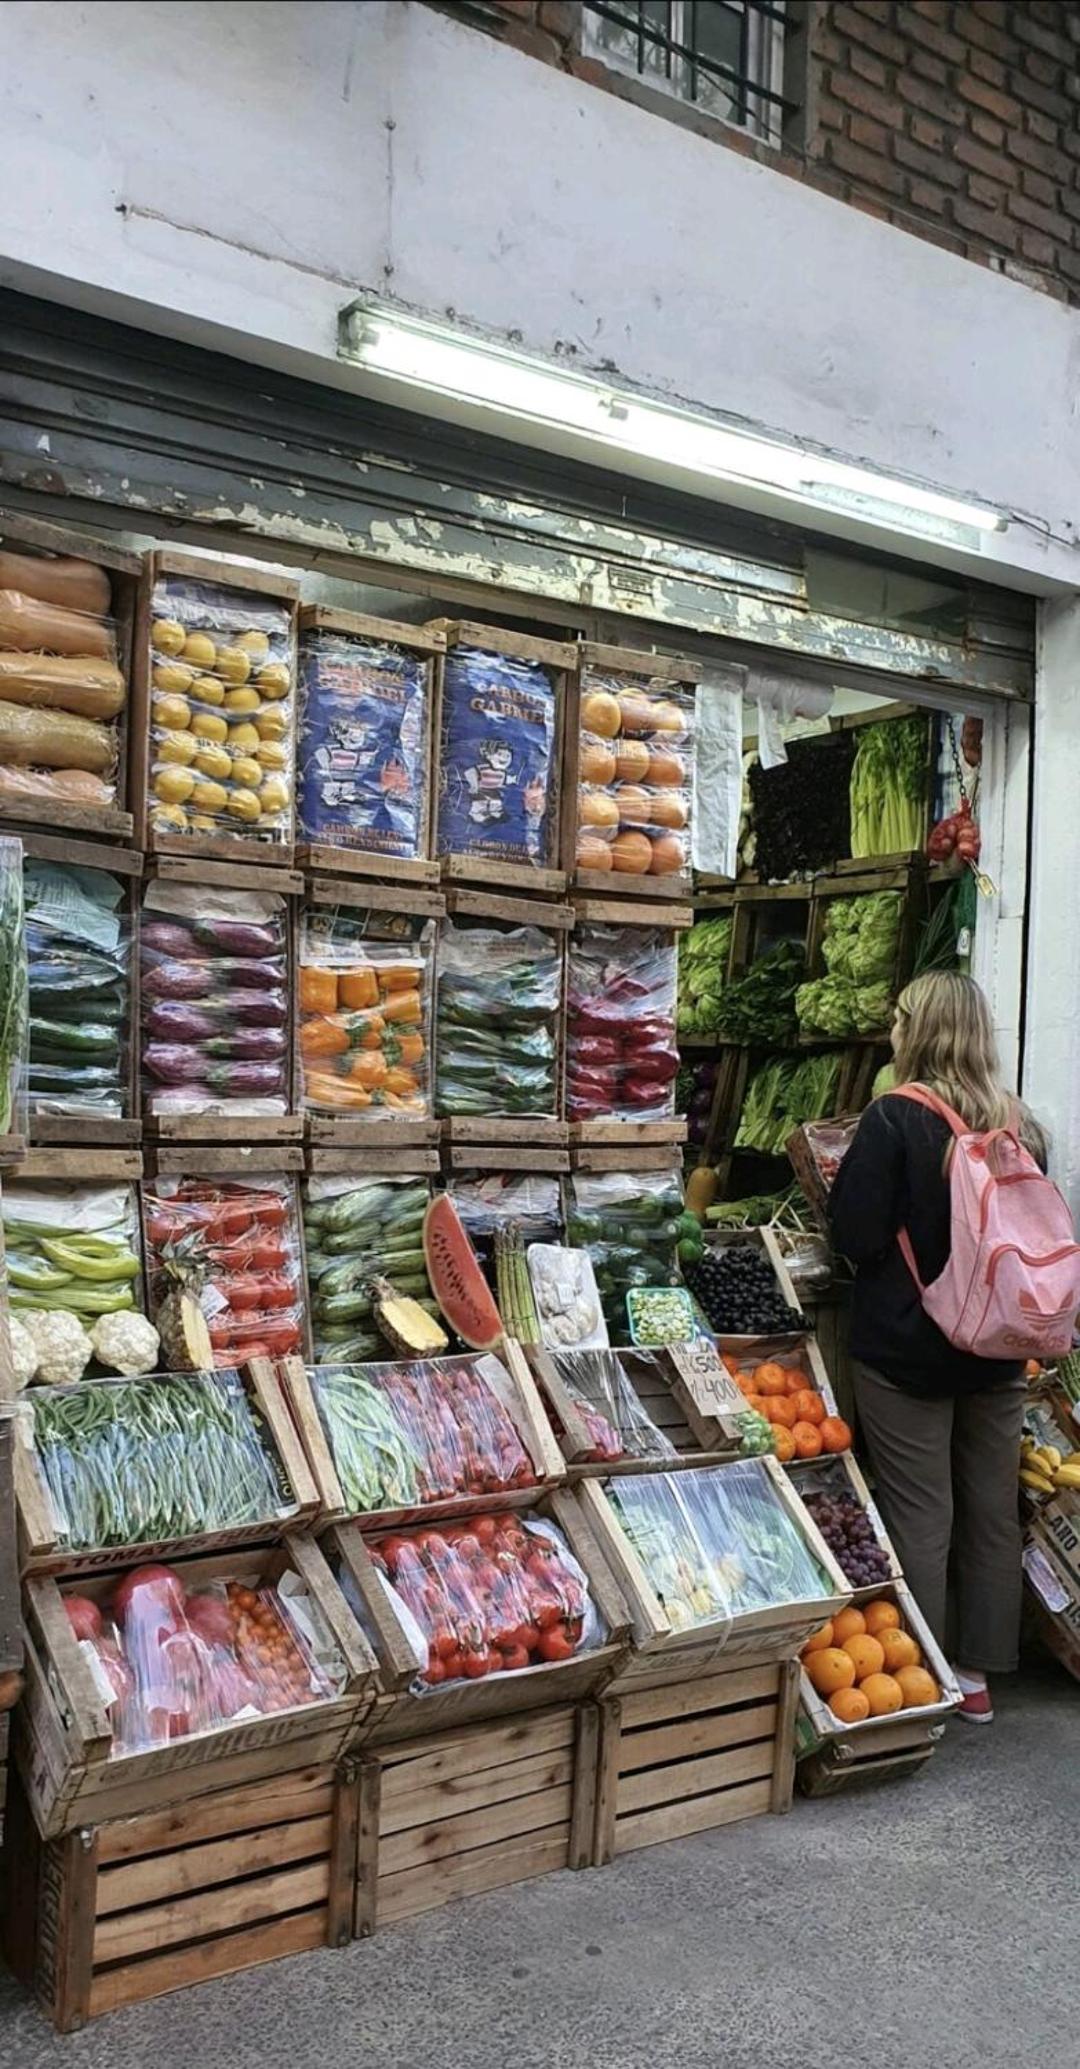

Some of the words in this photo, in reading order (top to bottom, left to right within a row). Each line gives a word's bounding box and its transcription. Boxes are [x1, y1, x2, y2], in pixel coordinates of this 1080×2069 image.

[1003, 1332, 1066, 1352] adidas
[704, 1377, 738, 1403] 400
[71, 1538, 209, 1568] TOMATES
